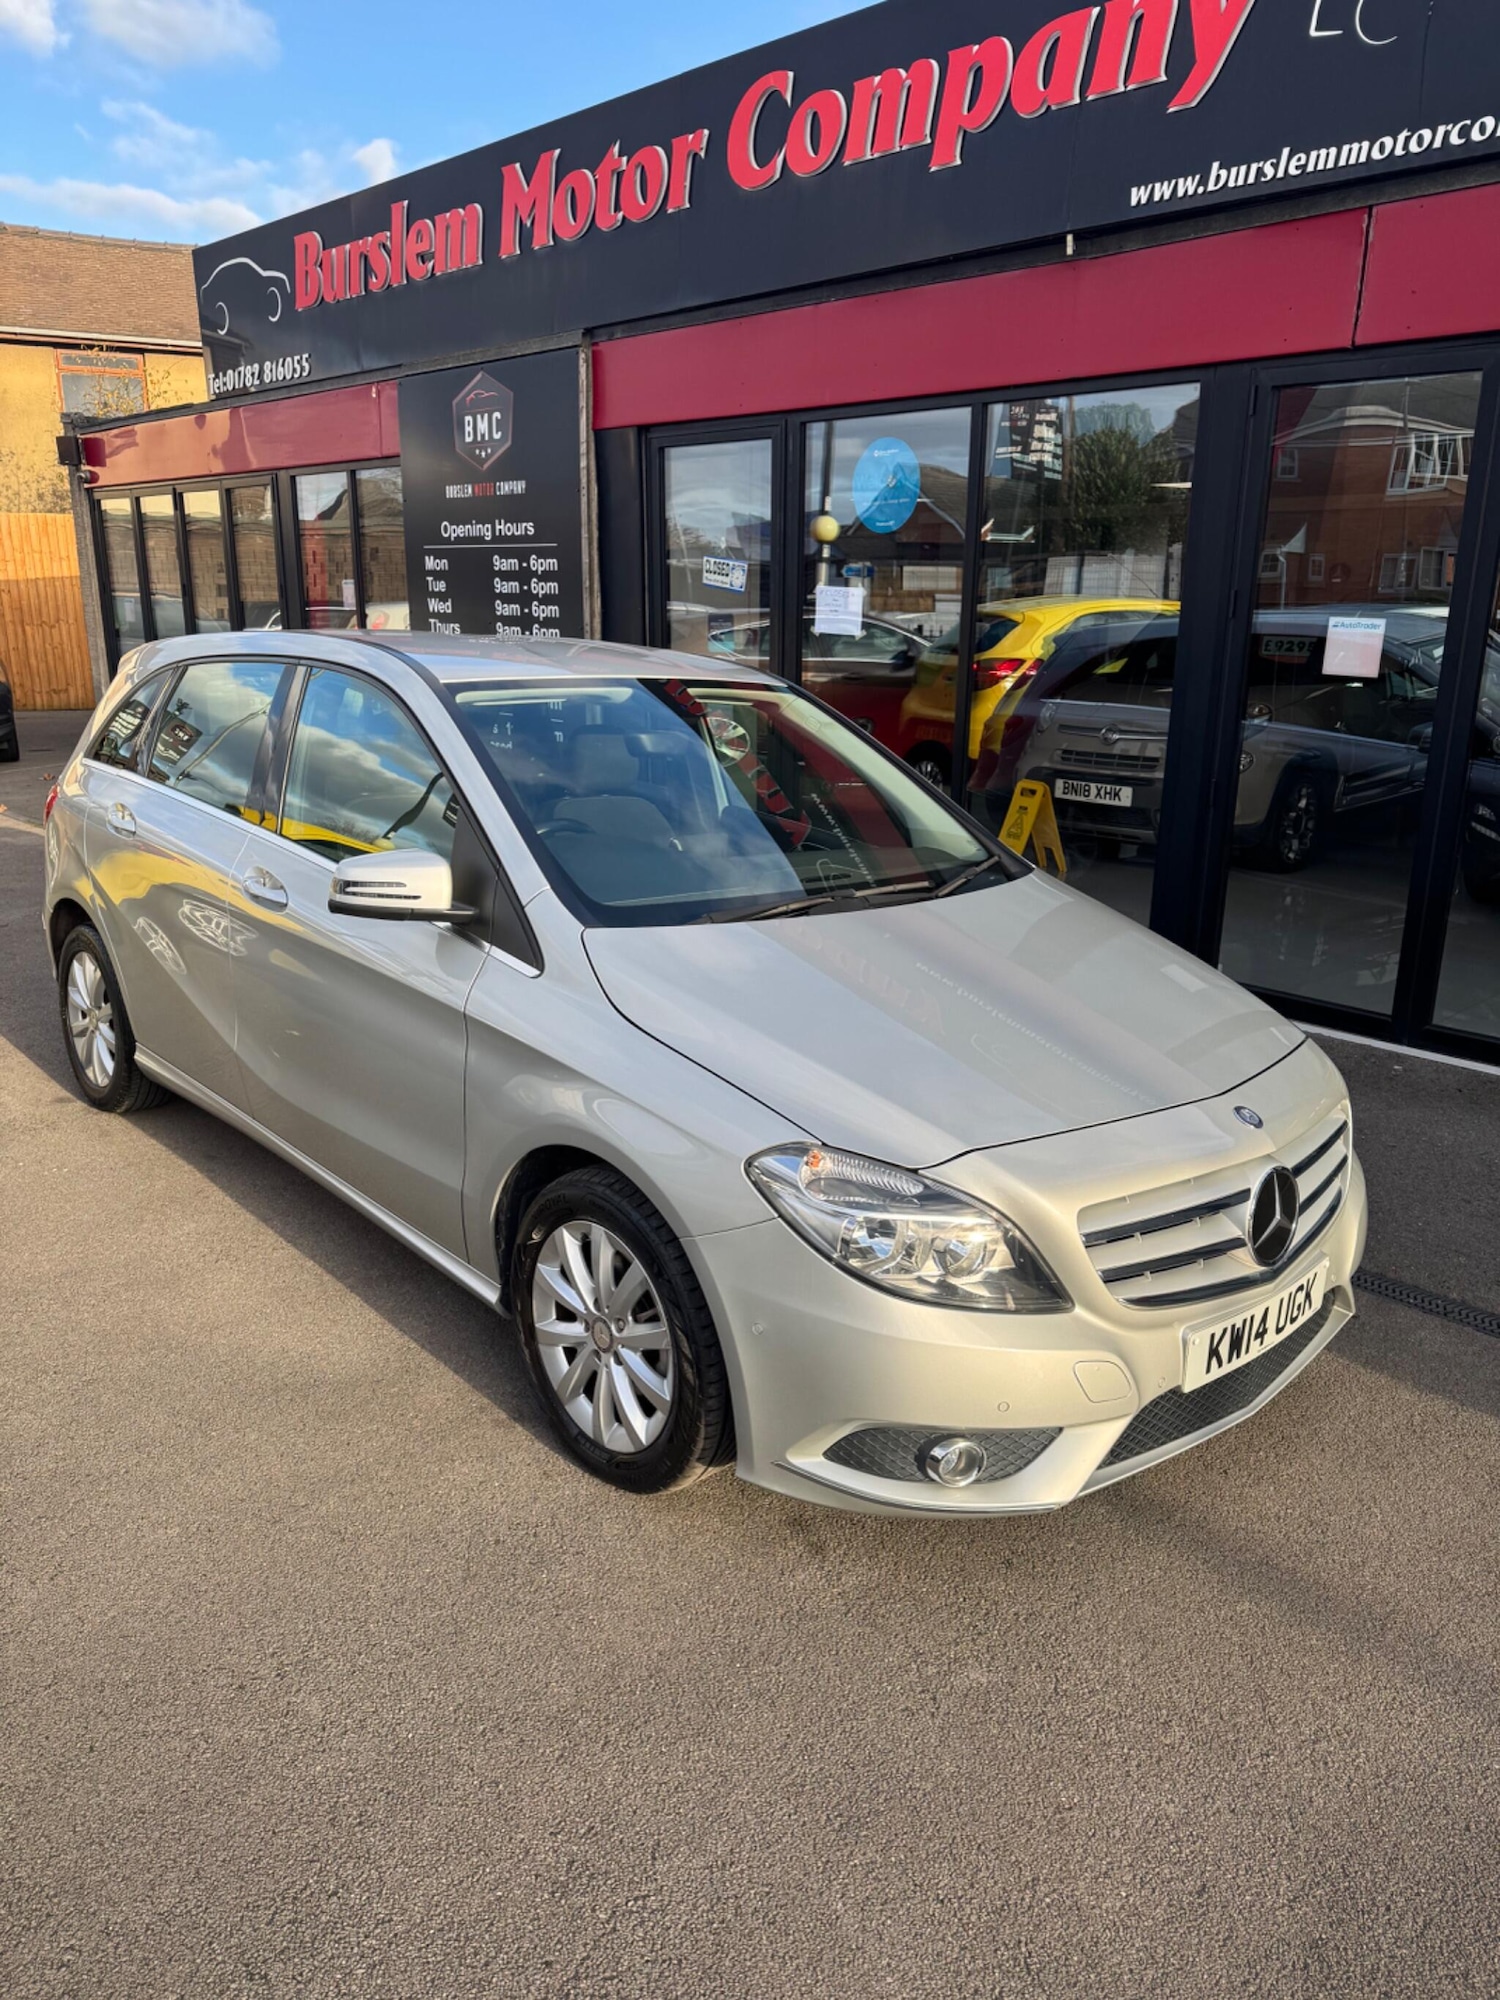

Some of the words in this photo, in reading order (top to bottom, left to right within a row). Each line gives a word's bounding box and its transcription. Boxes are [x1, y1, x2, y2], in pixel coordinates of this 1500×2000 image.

[294, 200, 484, 312] Burslem
[499, 128, 710, 260] Motor
[727, 0, 1257, 192] Company
[1130, 115, 1500, 207] www.burslemmotorco
[263, 353, 310, 383] 816055
[464, 411, 502, 442] BMC
[441, 520, 491, 541] Opening
[495, 519, 535, 536] Hours
[425, 556, 448, 571] Mon
[493, 555, 519, 571] 9am
[530, 555, 558, 575] 6pm
[426, 577, 446, 592] Tue
[494, 578, 520, 594] 9am
[531, 578, 559, 598] 6pm
[428, 598, 452, 613] Wed
[495, 600, 521, 616] 9am
[532, 601, 560, 620] 6pm
[429, 619, 461, 635] Thurs
[496, 622, 521, 637] 9am
[1340, 621, 1381, 630] AutoTrader
[1062, 781, 1091, 798] BN18
[1094, 785, 1122, 802] XHK
[1205, 1306, 1270, 1375] KW14
[1275, 1272, 1318, 1335] UGK
